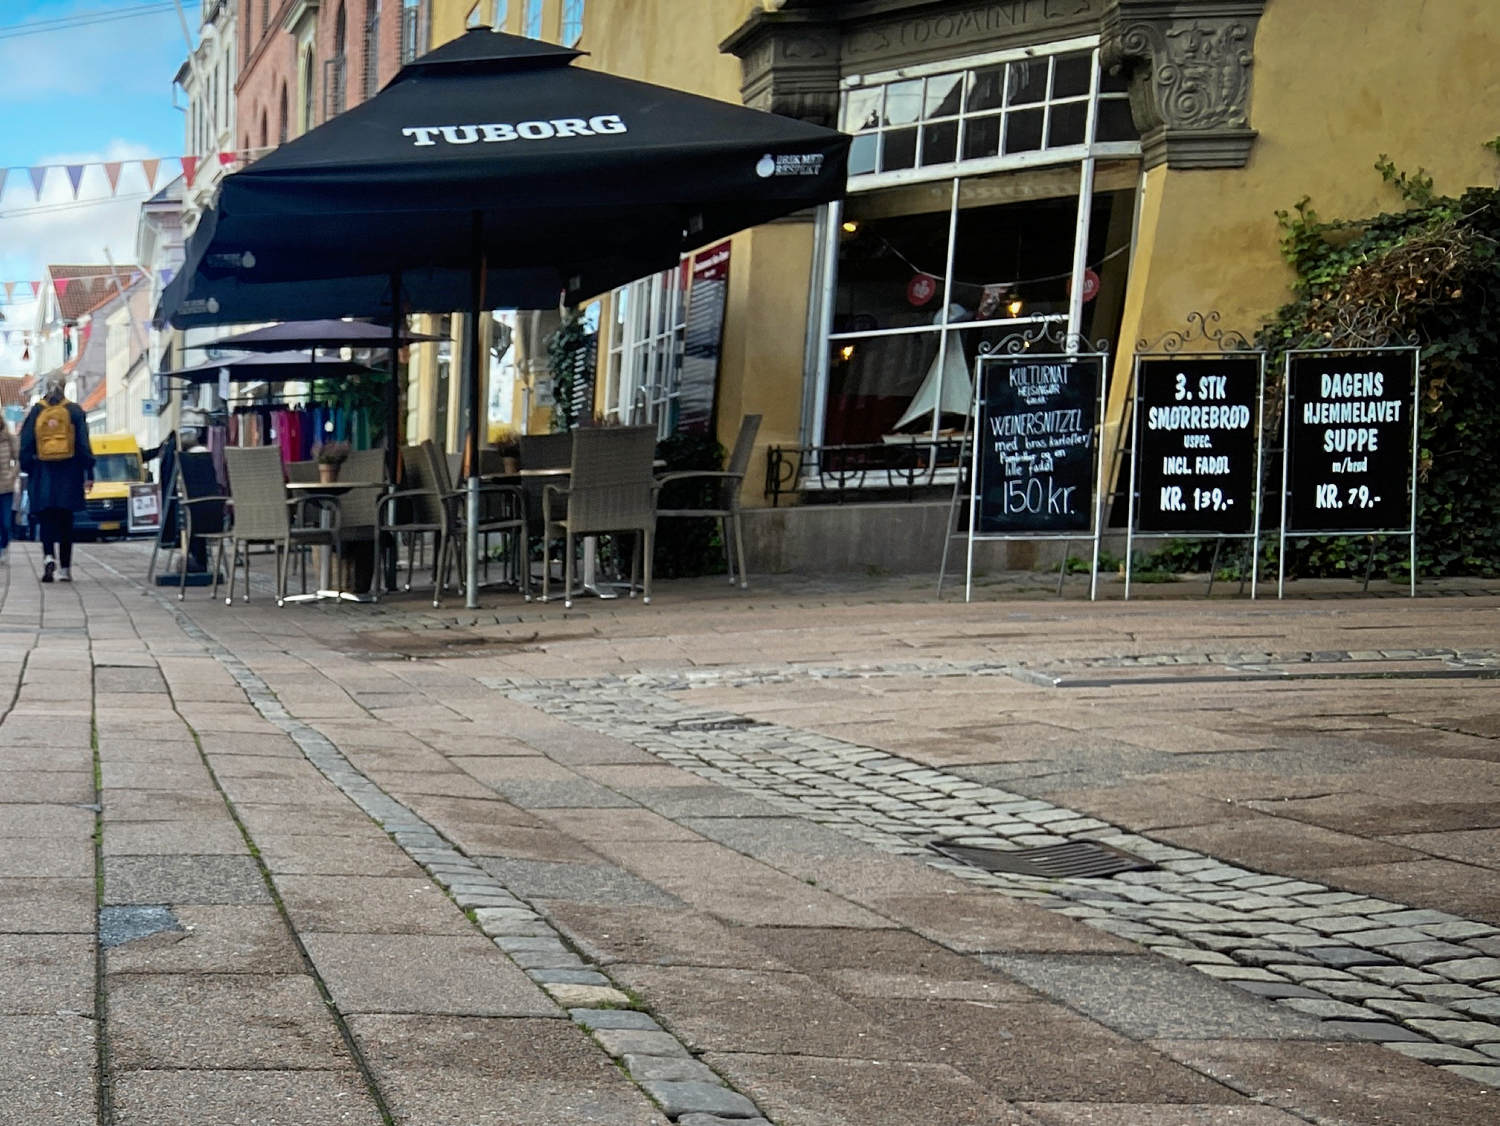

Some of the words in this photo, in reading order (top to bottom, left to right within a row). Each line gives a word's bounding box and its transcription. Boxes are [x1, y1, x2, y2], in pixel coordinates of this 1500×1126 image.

[402, 115, 627, 146] TUBORG
[1009, 364, 1073, 387] KULTURNAT
[1175, 373, 1192, 400] 3.
[1199, 375, 1227, 400] STK
[1321, 372, 1384, 399] DAGENS
[990, 409, 1082, 437] WEINERSNITZEL
[1148, 405, 1250, 431] SMØRREBRØD
[1303, 400, 1402, 424] HJEMMELAVET
[995, 436, 1018, 452] med
[1323, 428, 1378, 452] SUPPE
[1163, 456, 1192, 475] INCL.
[1195, 456, 1230, 475] FADØL
[1003, 477, 1042, 514] 150
[1048, 476, 1077, 515] kr.
[1160, 486, 1187, 511] KR.
[1194, 488, 1234, 511] 139.-
[1316, 483, 1343, 508] KR.
[1348, 485, 1381, 508] 79.-
